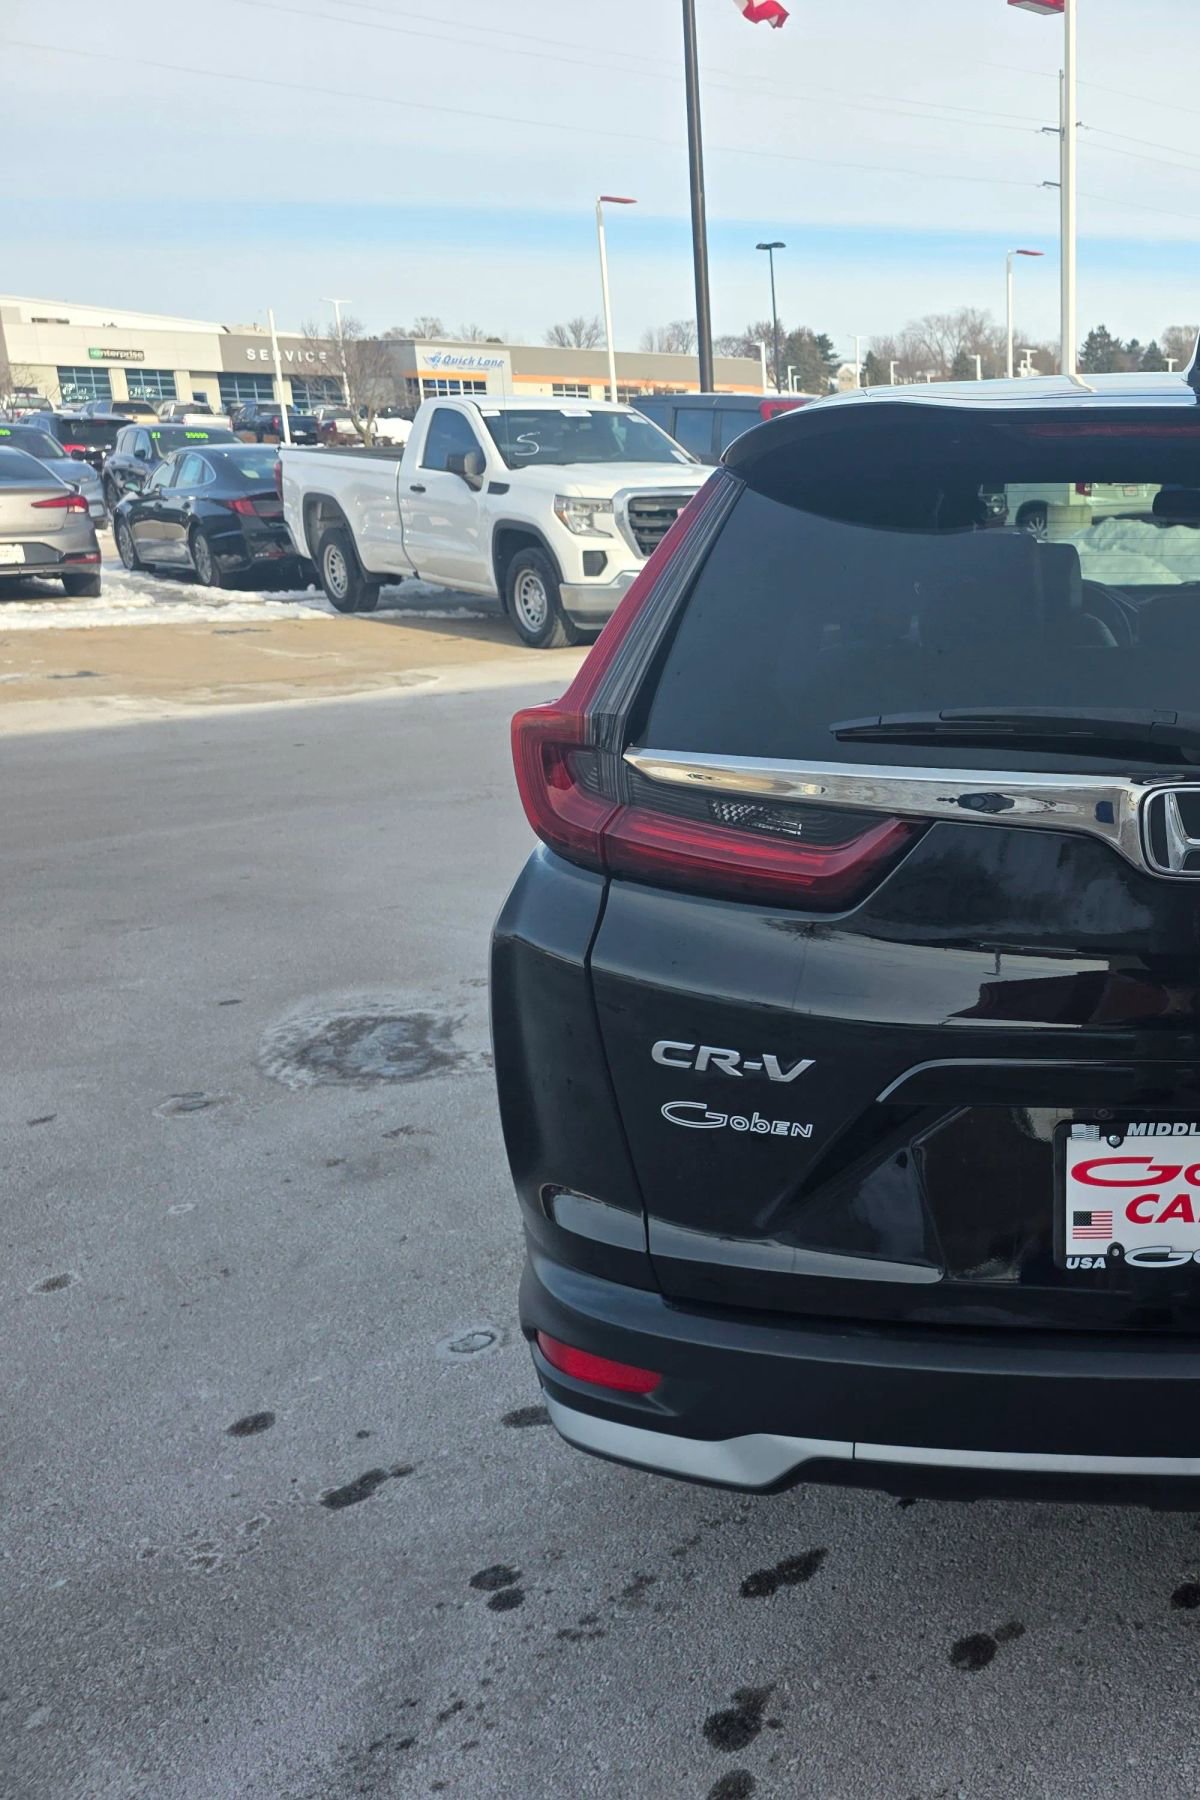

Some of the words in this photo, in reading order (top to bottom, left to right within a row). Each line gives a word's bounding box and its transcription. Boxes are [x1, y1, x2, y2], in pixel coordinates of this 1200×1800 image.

[443, 354, 475, 367] Quick
[478, 356, 505, 368] Lane
[651, 1040, 816, 1082] CR-V
[1065, 1257, 1106, 1270] USA
